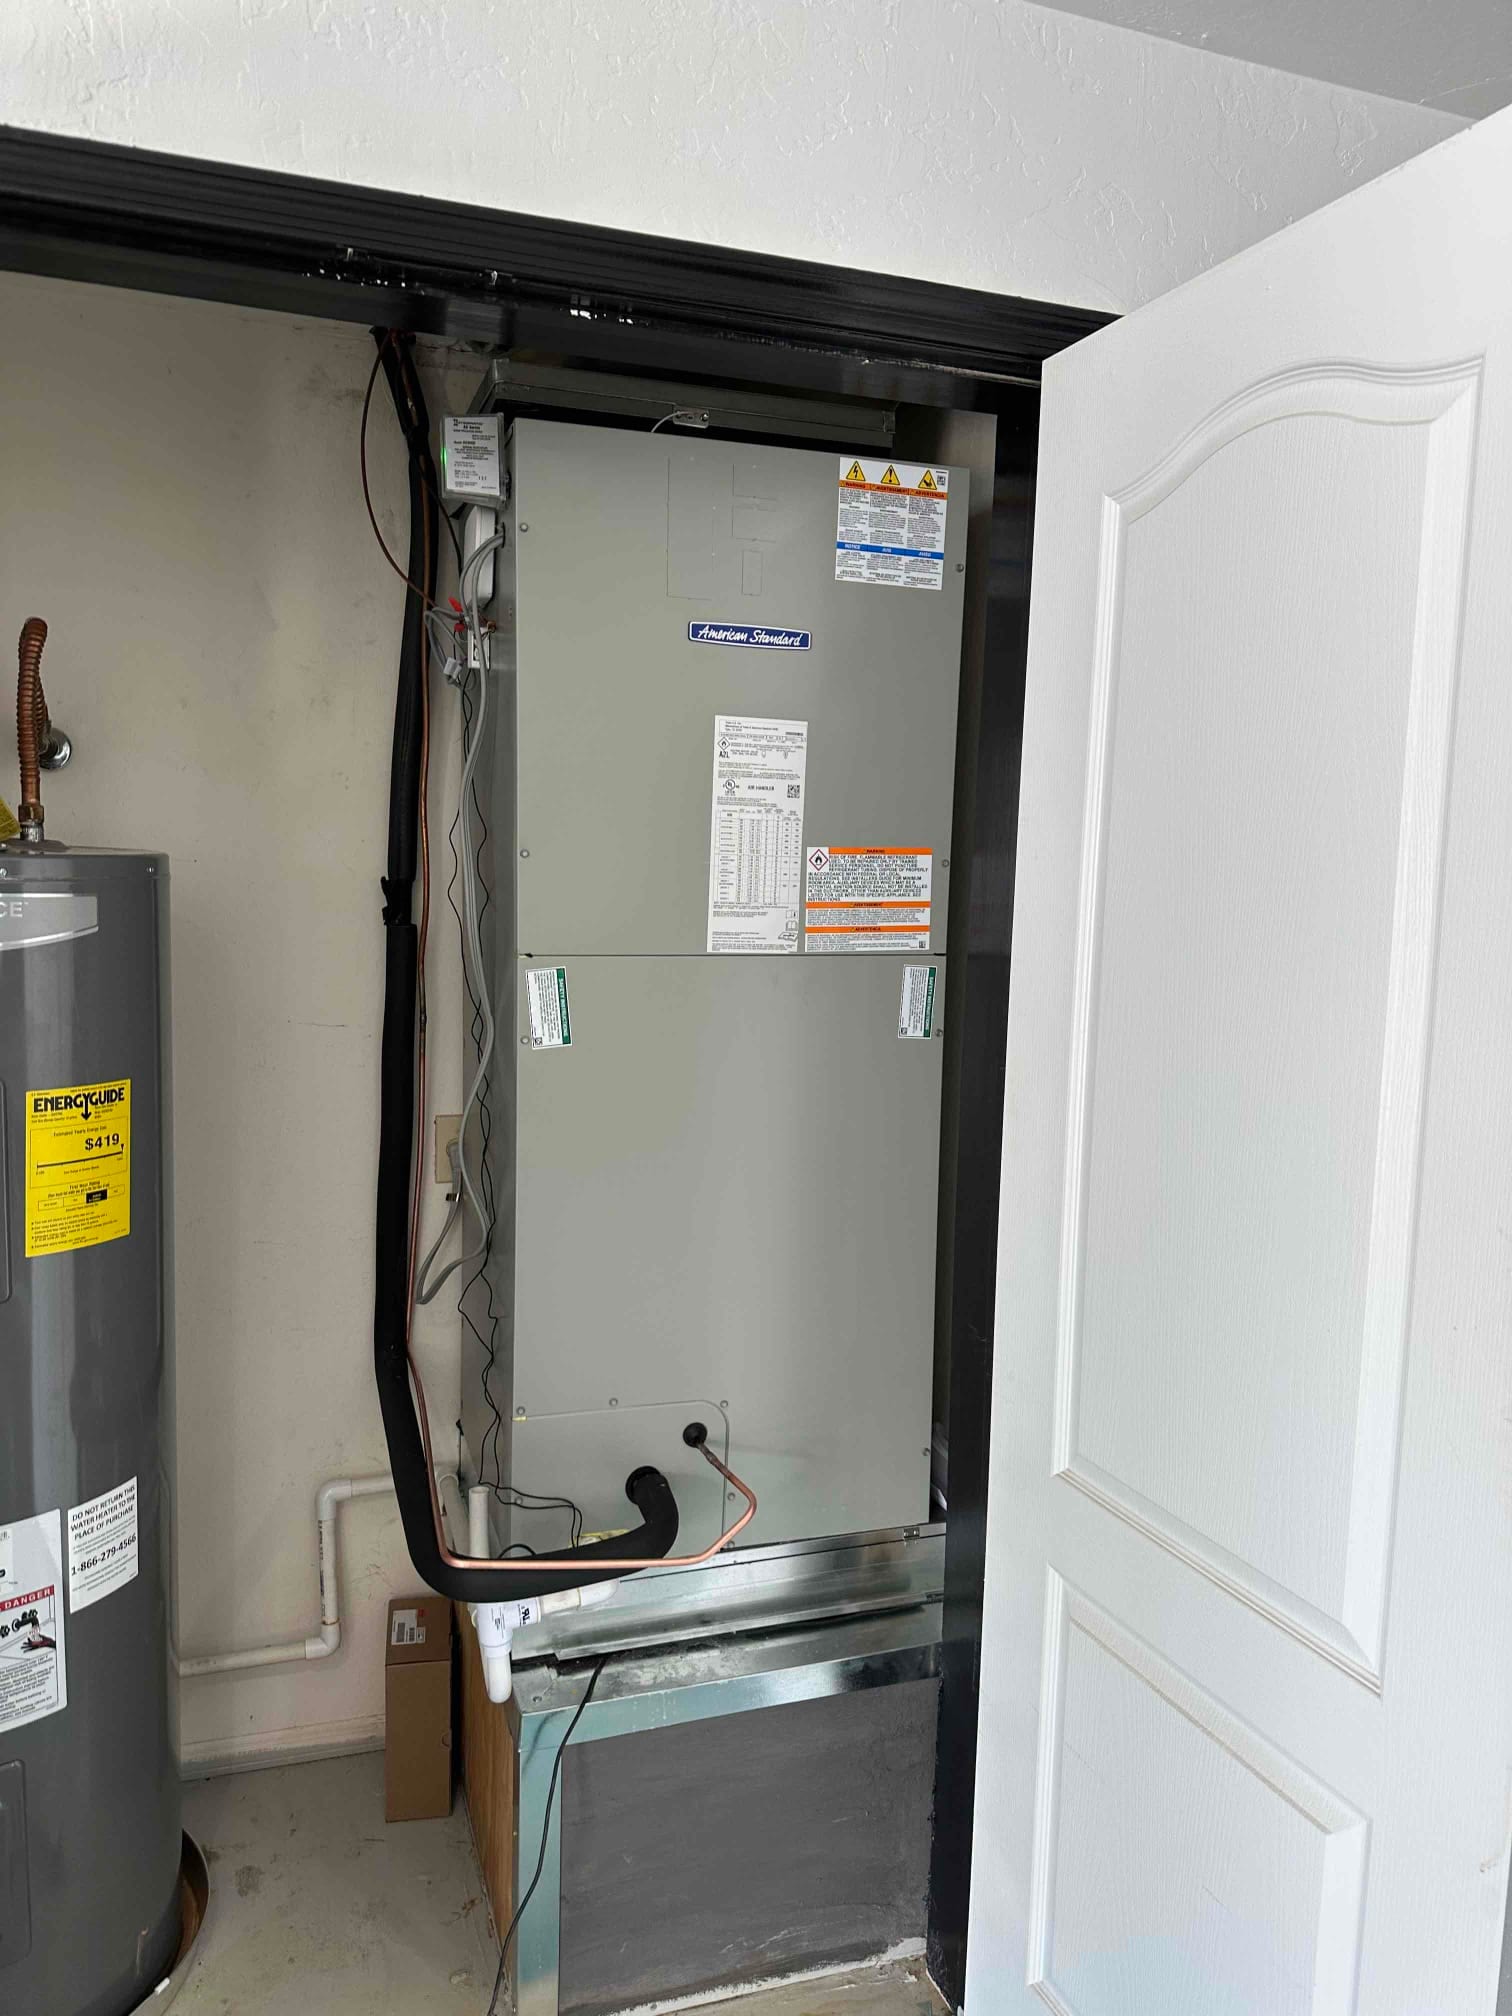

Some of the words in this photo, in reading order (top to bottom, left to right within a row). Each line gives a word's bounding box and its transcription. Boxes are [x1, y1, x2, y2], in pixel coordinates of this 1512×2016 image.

[697, 625, 748, 642] American
[750, 629, 803, 646] Standard
[34, 1088, 124, 1112] ENERGYGUIDE
[85, 1133, 119, 1151] $419
[70, 1518, 95, 1531] WATER
[96, 1504, 117, 1520] HEATER
[72, 1512, 83, 1521] DO
[85, 1505, 99, 1516] NOT
[100, 1492, 123, 1509] RETURN
[74, 1526, 93, 1540] PLACE
[96, 1520, 104, 1530] OF
[105, 1504, 133, 1526] PURCHASE
[71, 1532, 136, 1576] 1-866-279-4566
[5, 1587, 51, 1608] DANGER
